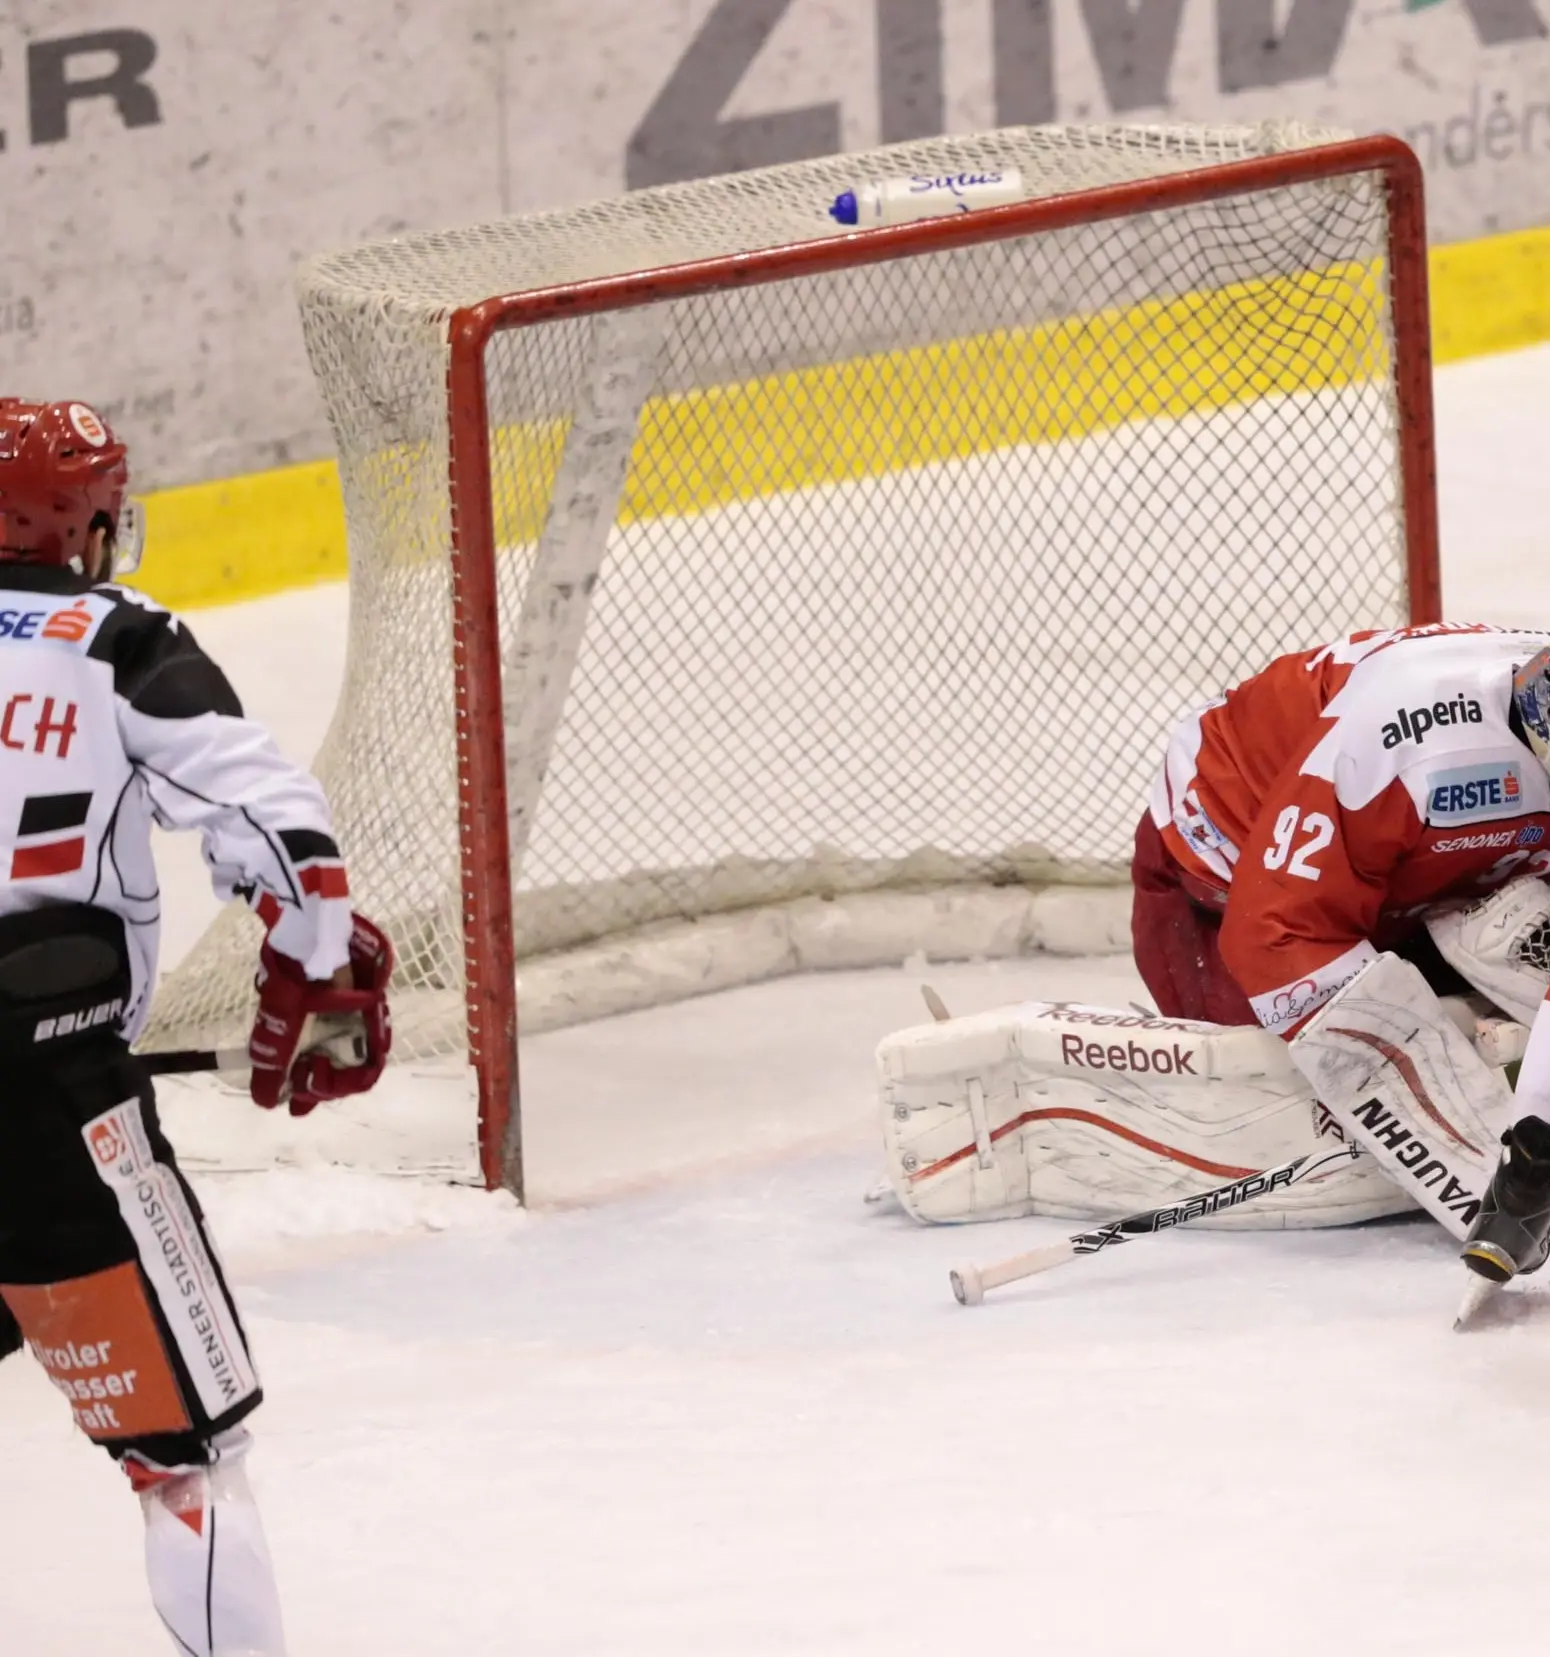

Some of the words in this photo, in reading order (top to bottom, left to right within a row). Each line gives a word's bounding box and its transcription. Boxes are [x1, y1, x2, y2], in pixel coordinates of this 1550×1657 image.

[0, 27, 163, 152] R
[1381, 692, 1484, 750] alperia
[1432, 778, 1501, 812] ERSTE
[1263, 804, 1336, 882] 92
[1431, 830, 1517, 853] SENONER
[1061, 1033, 1199, 1076] Reebok
[1353, 1096, 1483, 1228] VAUGHN
[34, 1338, 111, 1371] roler
[188, 1299, 239, 1404] WIENER
[52, 1370, 137, 1400] asser
[73, 1402, 121, 1429] raft
